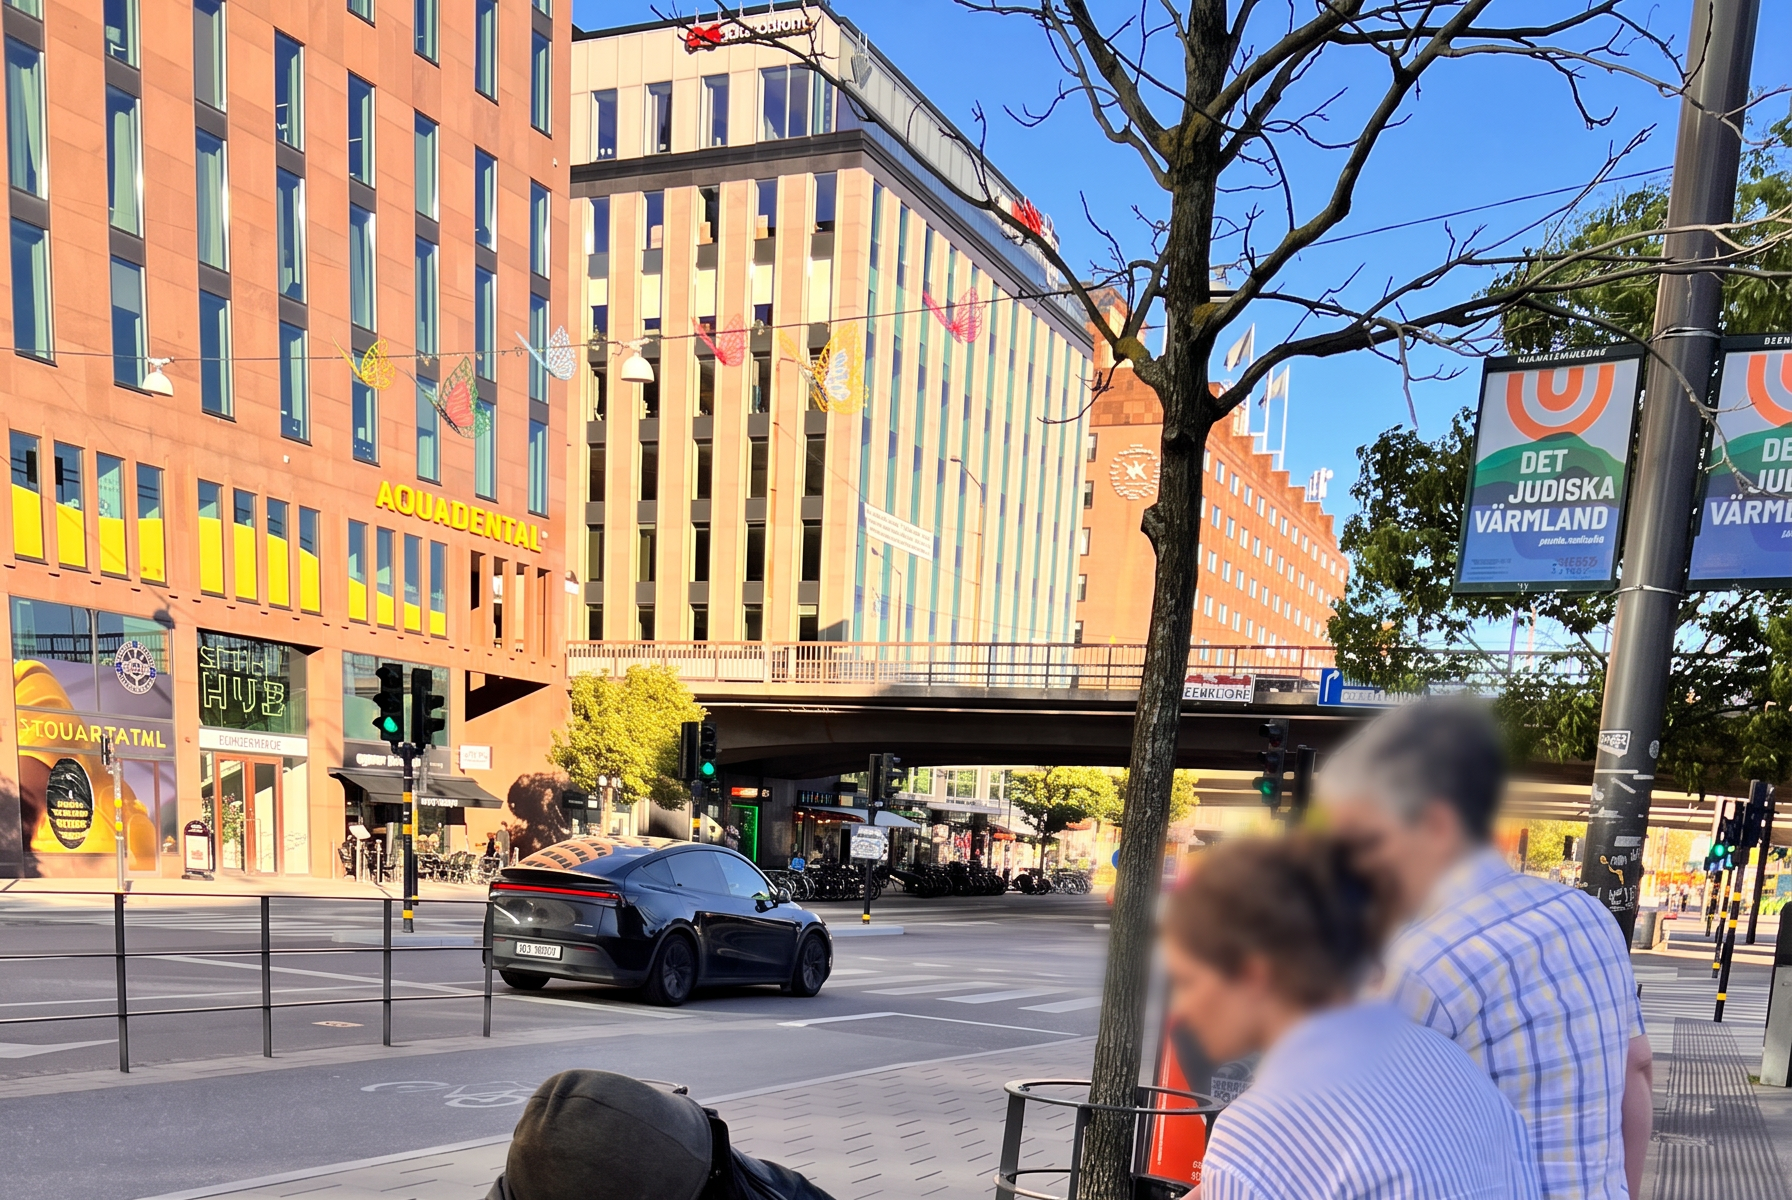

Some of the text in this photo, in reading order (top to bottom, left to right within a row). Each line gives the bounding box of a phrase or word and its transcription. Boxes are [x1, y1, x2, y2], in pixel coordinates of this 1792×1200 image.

[1520, 449, 1568, 474] DET
[1508, 476, 1615, 503] JUDISKA
[1475, 504, 1608, 533] VÄRMLAND
